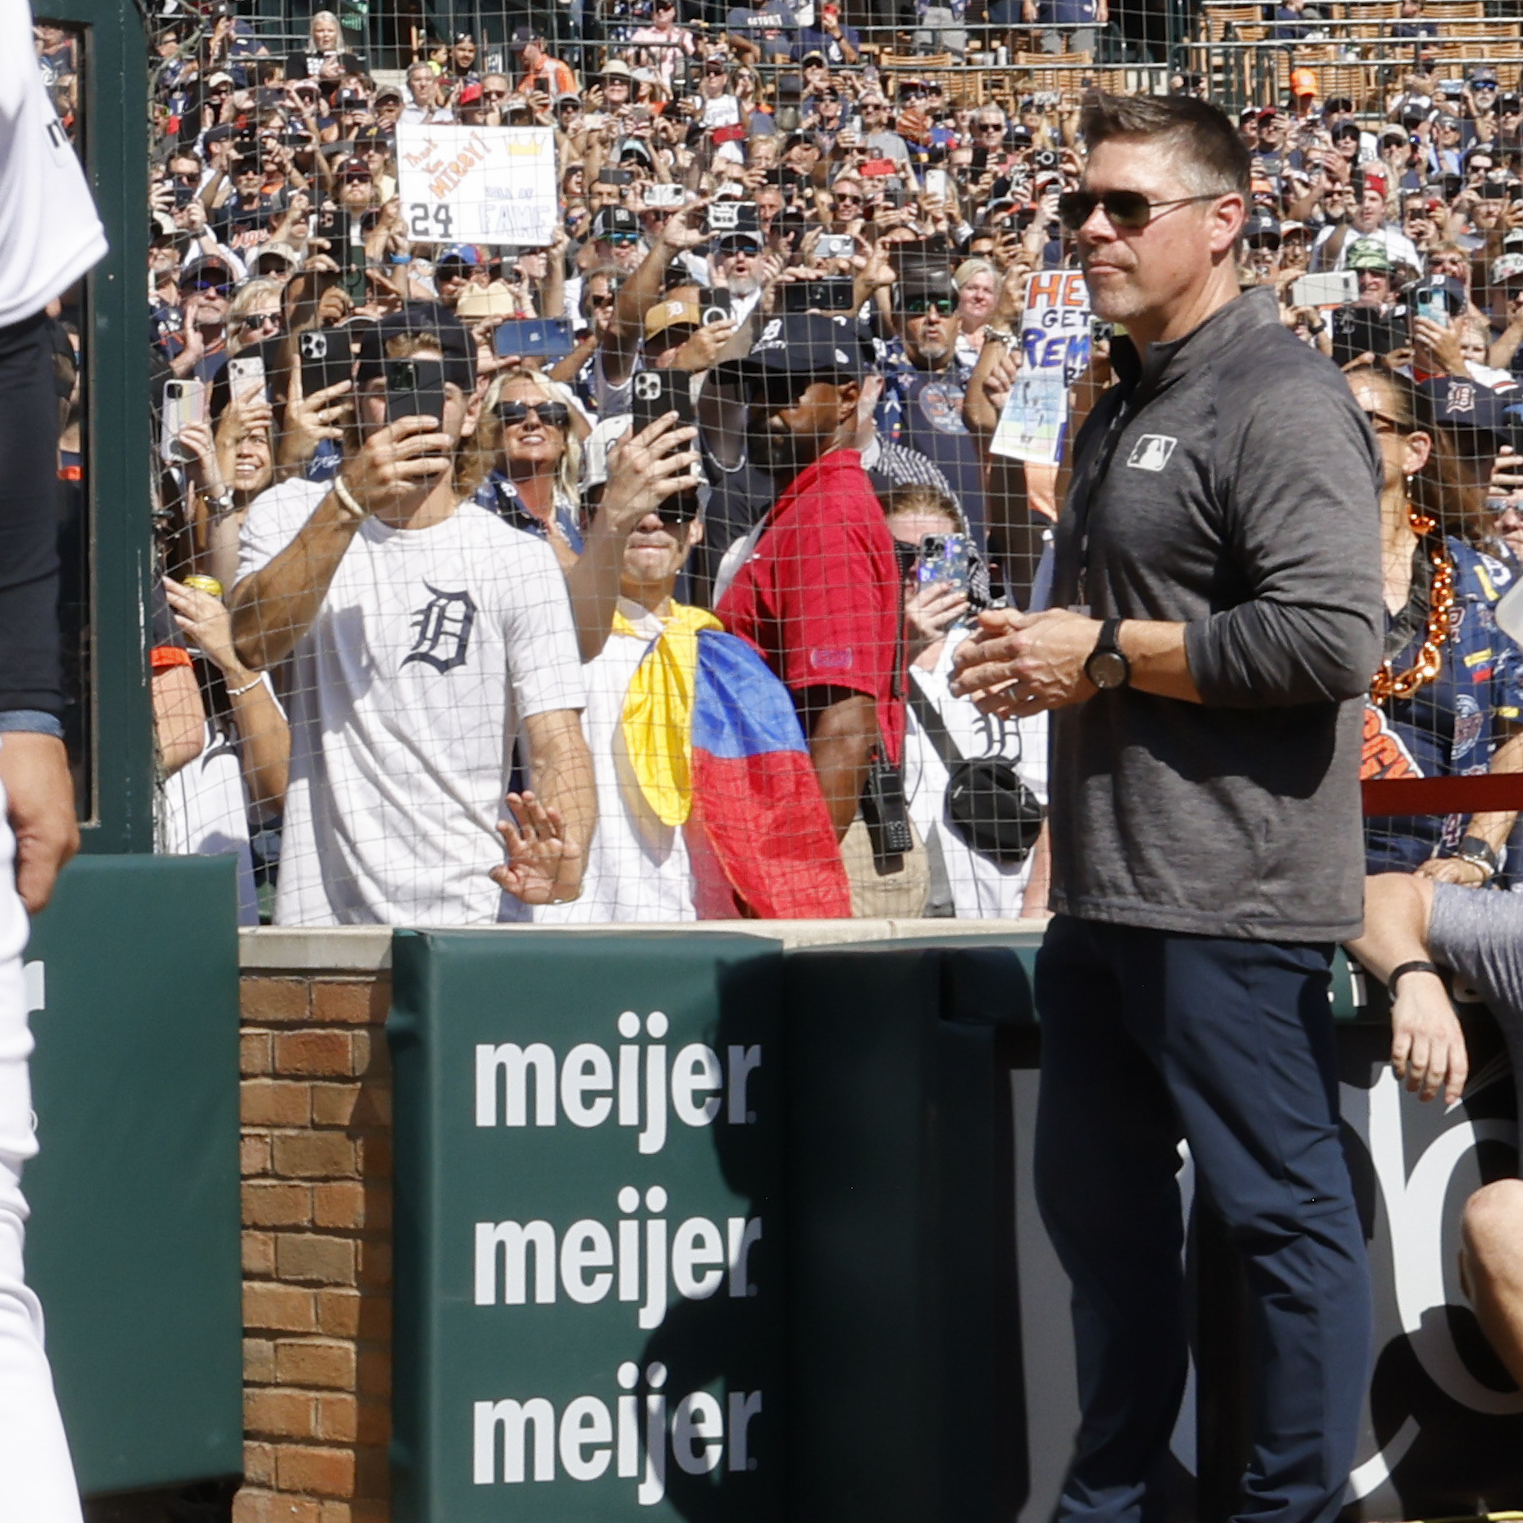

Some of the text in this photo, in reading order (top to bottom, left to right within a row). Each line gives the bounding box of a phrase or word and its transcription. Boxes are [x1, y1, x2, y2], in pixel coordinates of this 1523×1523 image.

[410, 203, 551, 240] 24 FAME
[398, 575, 478, 675] D
[475, 1011, 762, 1155] meijer
[474, 1185, 763, 1330] meijer
[474, 1361, 763, 1506] meijer
